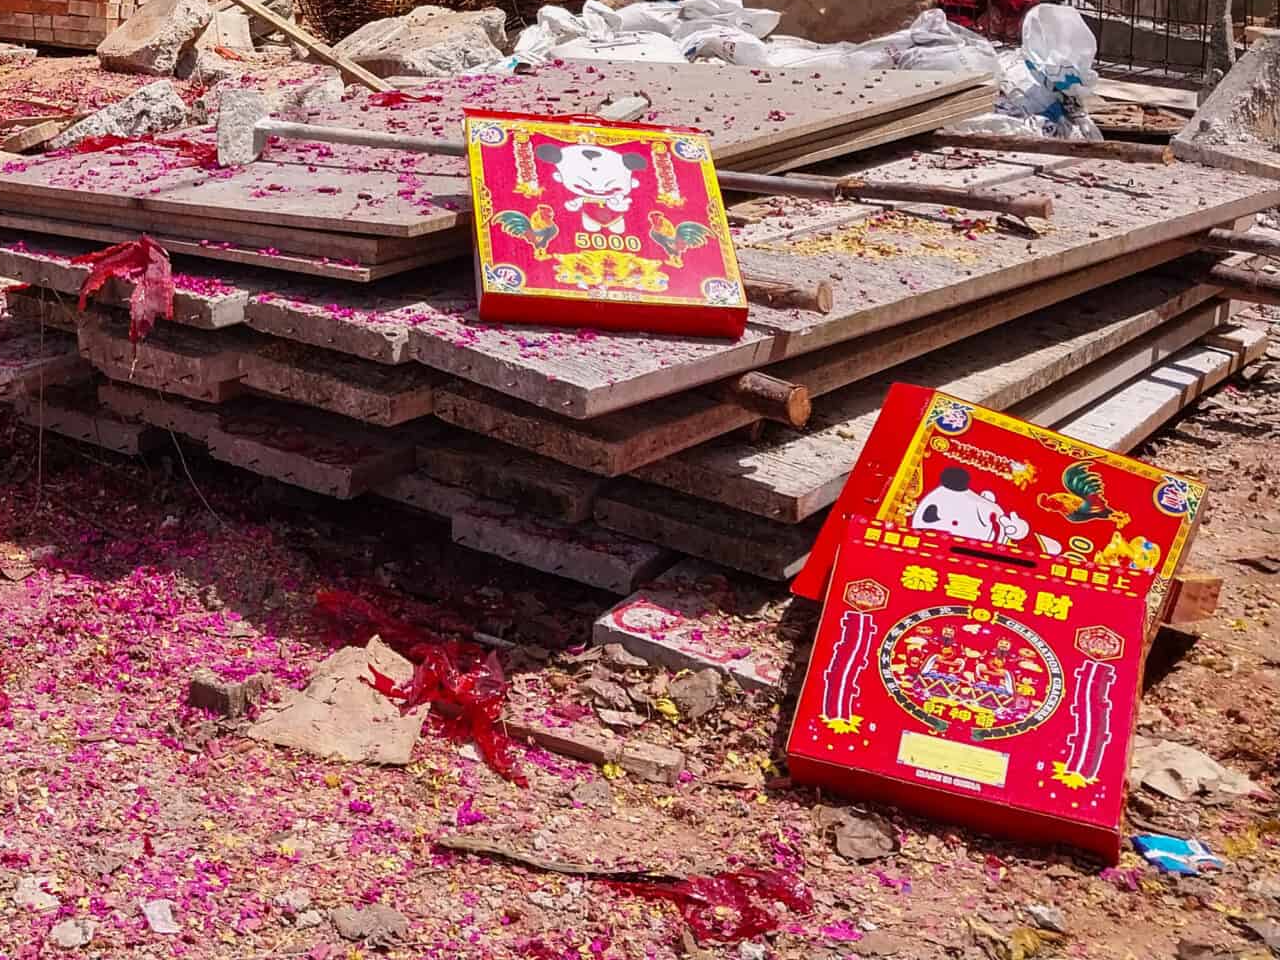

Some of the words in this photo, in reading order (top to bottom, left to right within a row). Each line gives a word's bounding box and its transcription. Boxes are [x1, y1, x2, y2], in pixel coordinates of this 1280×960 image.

[575, 232, 641, 252] 5000
[899, 564, 1073, 621] 恭喜發財
